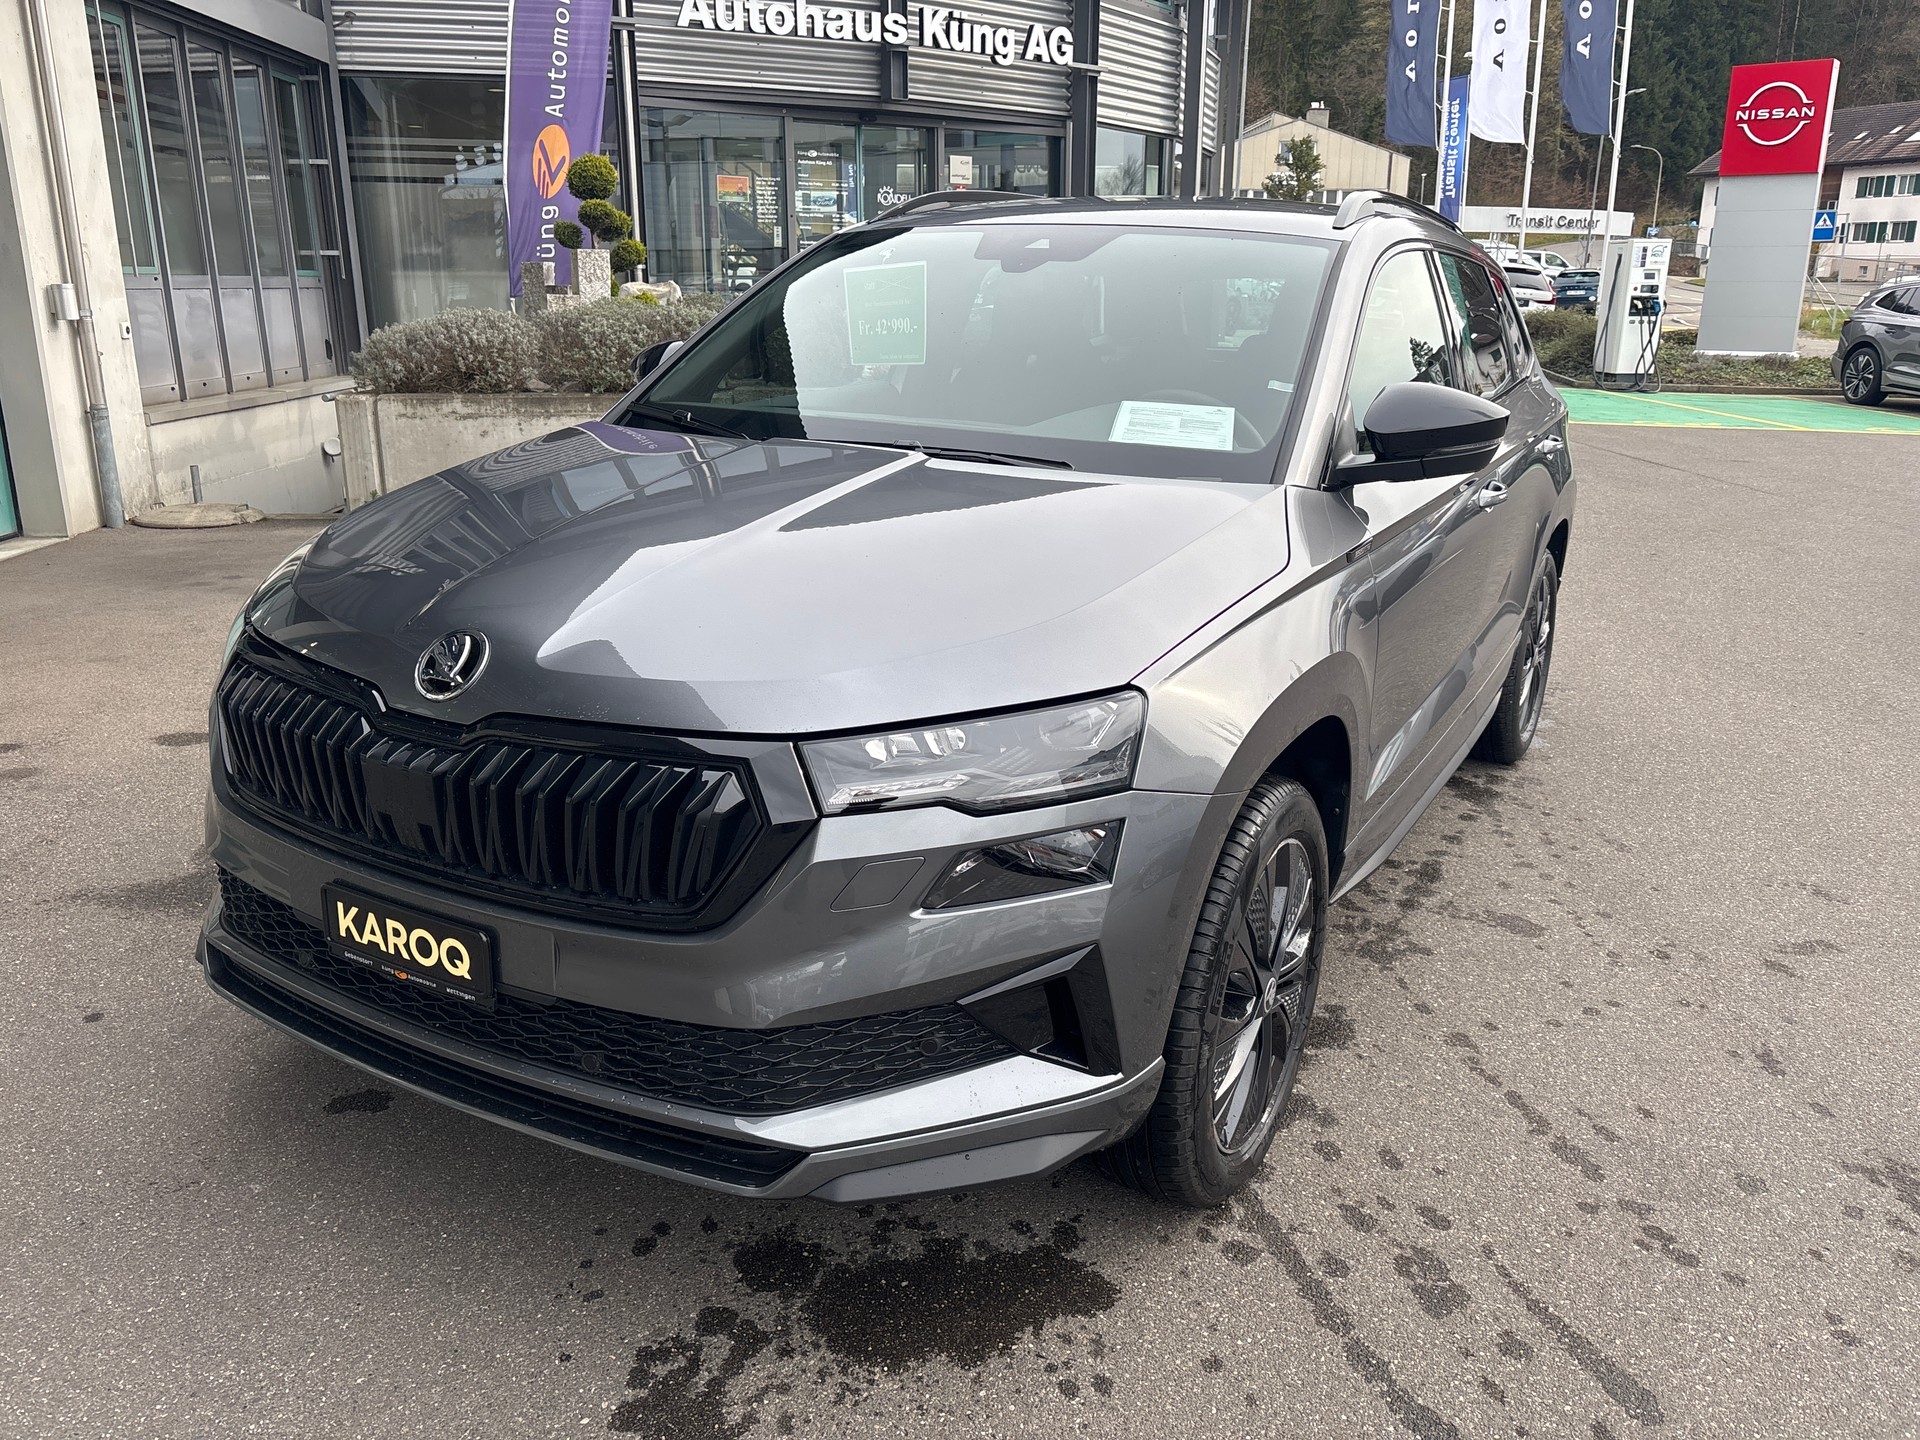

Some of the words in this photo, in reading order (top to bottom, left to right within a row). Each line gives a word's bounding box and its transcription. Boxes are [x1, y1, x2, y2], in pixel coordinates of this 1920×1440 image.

[545, 0, 571, 117] Automo
[677, 0, 908, 44] Autohaus
[921, 7, 1015, 66] Küng
[1023, 23, 1074, 65] AG
[1735, 106, 1815, 121] NISSAN
[536, 205, 559, 264] üng
[858, 320, 874, 336] Fr.
[337, 901, 472, 980] KAROQ
